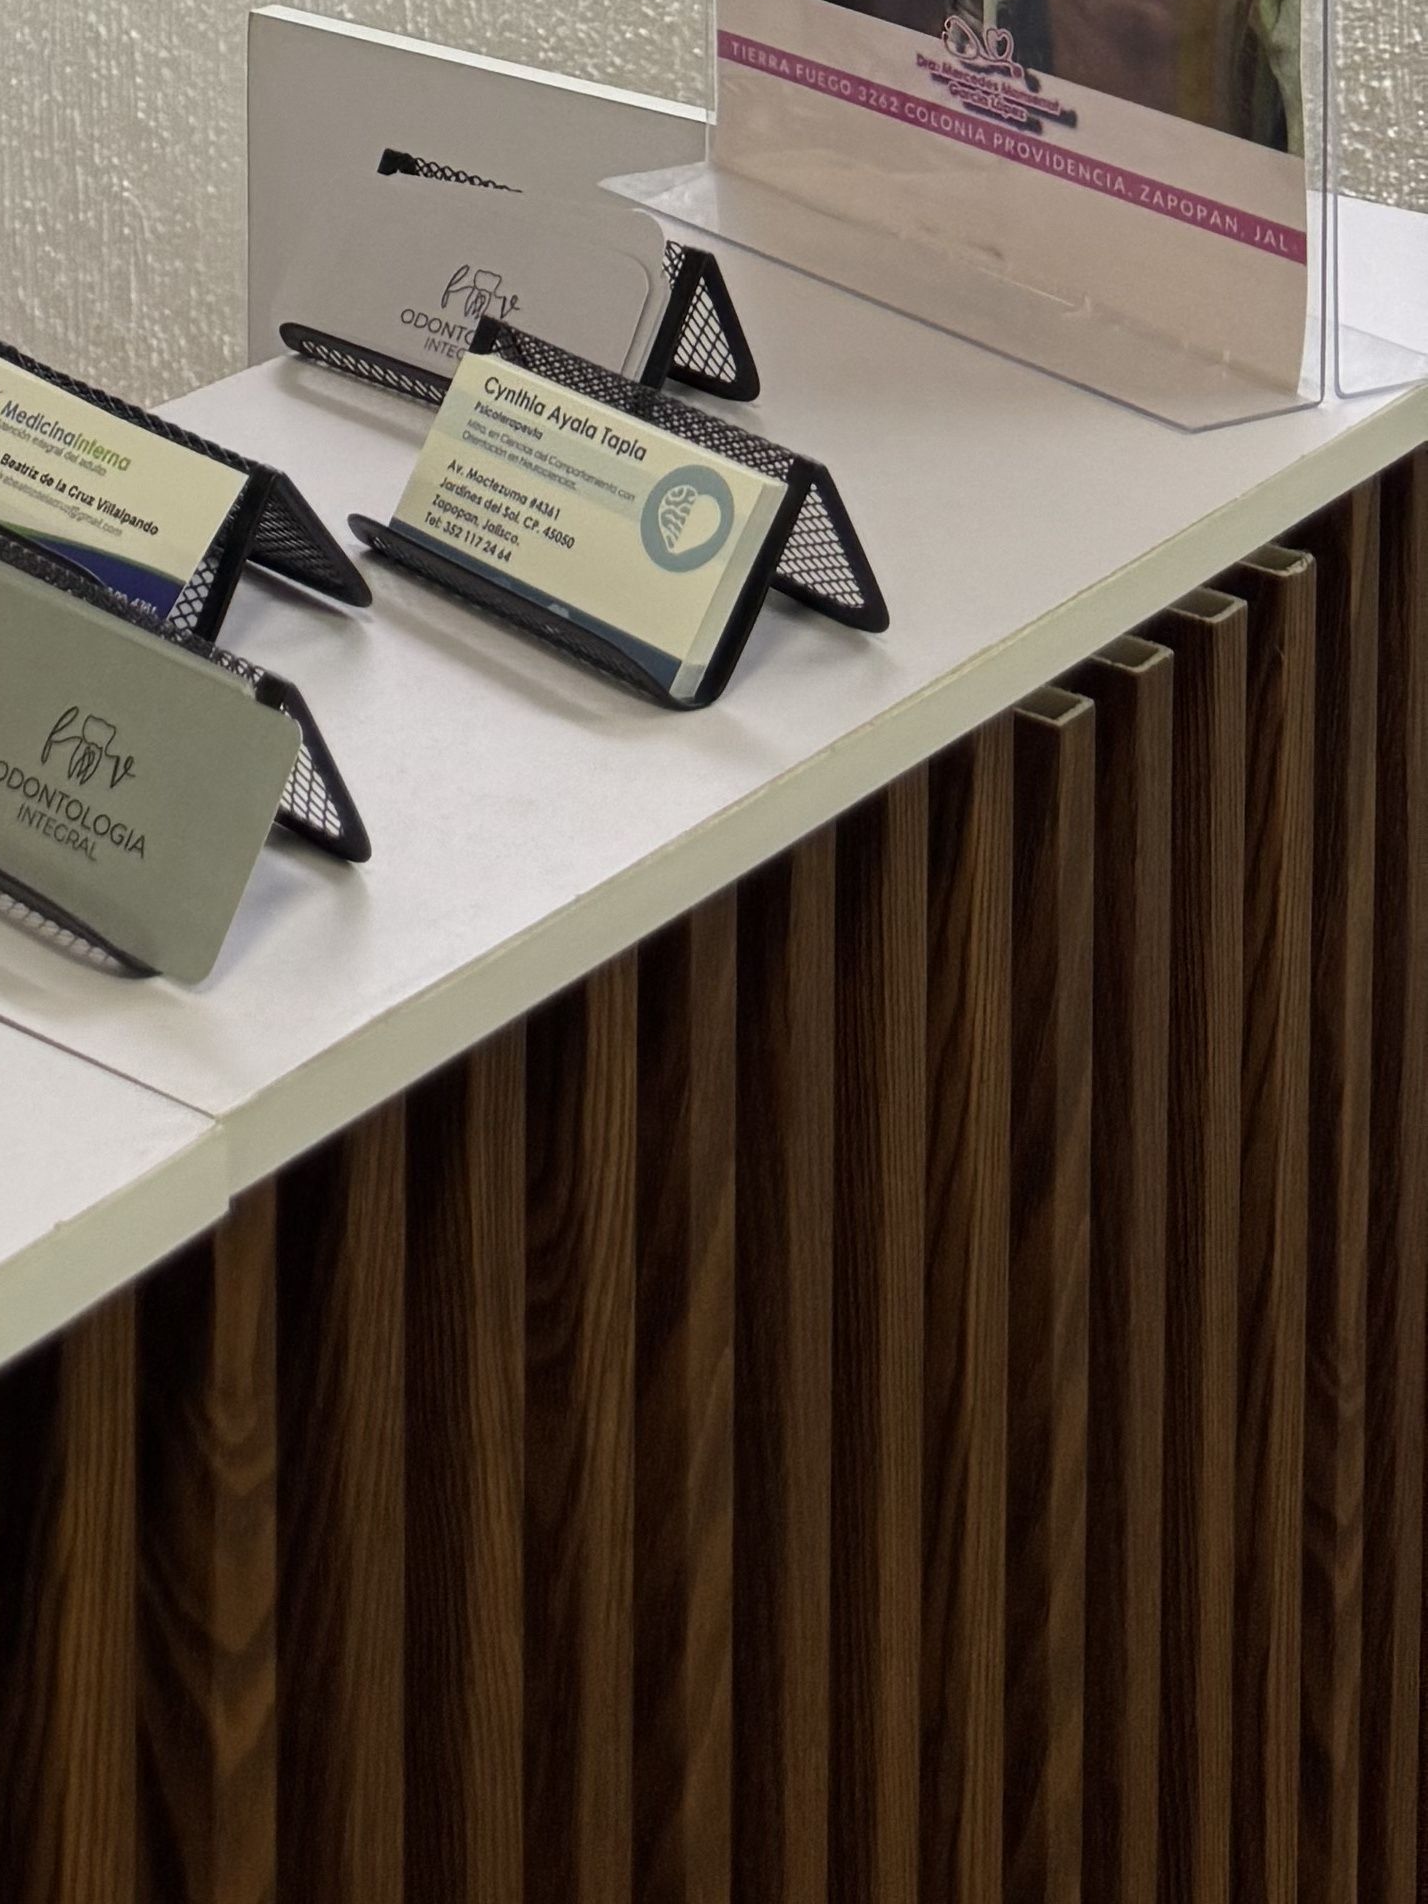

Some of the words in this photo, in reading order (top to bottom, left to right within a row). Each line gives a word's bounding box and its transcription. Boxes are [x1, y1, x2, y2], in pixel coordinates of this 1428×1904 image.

[730, 41, 790, 75] TIERRA
[796, 63, 851, 97] FUEGO
[858, 86, 899, 114] 3262
[905, 103, 987, 145] COLONIA
[474, 401, 544, 441] Psicoterapeuta
[484, 376, 545, 417] Cynthia
[547, 405, 598, 440] Ayala
[600, 426, 648, 461] Tapia
[64, 450, 78, 464] del
[0, 452, 38, 480] Beatriz
[40, 471, 54, 488] de
[55, 478, 66, 493] la
[68, 485, 95, 507] Cruz
[97, 497, 159, 536] Villalpando
[440, 477, 482, 505] Jardines
[484, 499, 502, 515] del
[543, 526, 576, 550] 45050
[447, 459, 464, 475] Av.
[466, 467, 528, 505] Moctezuma
[529, 497, 561, 521] #4361
[443, 521, 463, 539] 352
[464, 529, 482, 547] 117
[483, 541, 496, 555] 24
[497, 547, 512, 562] 64
[17, 802, 98, 862] INTEGRAL
